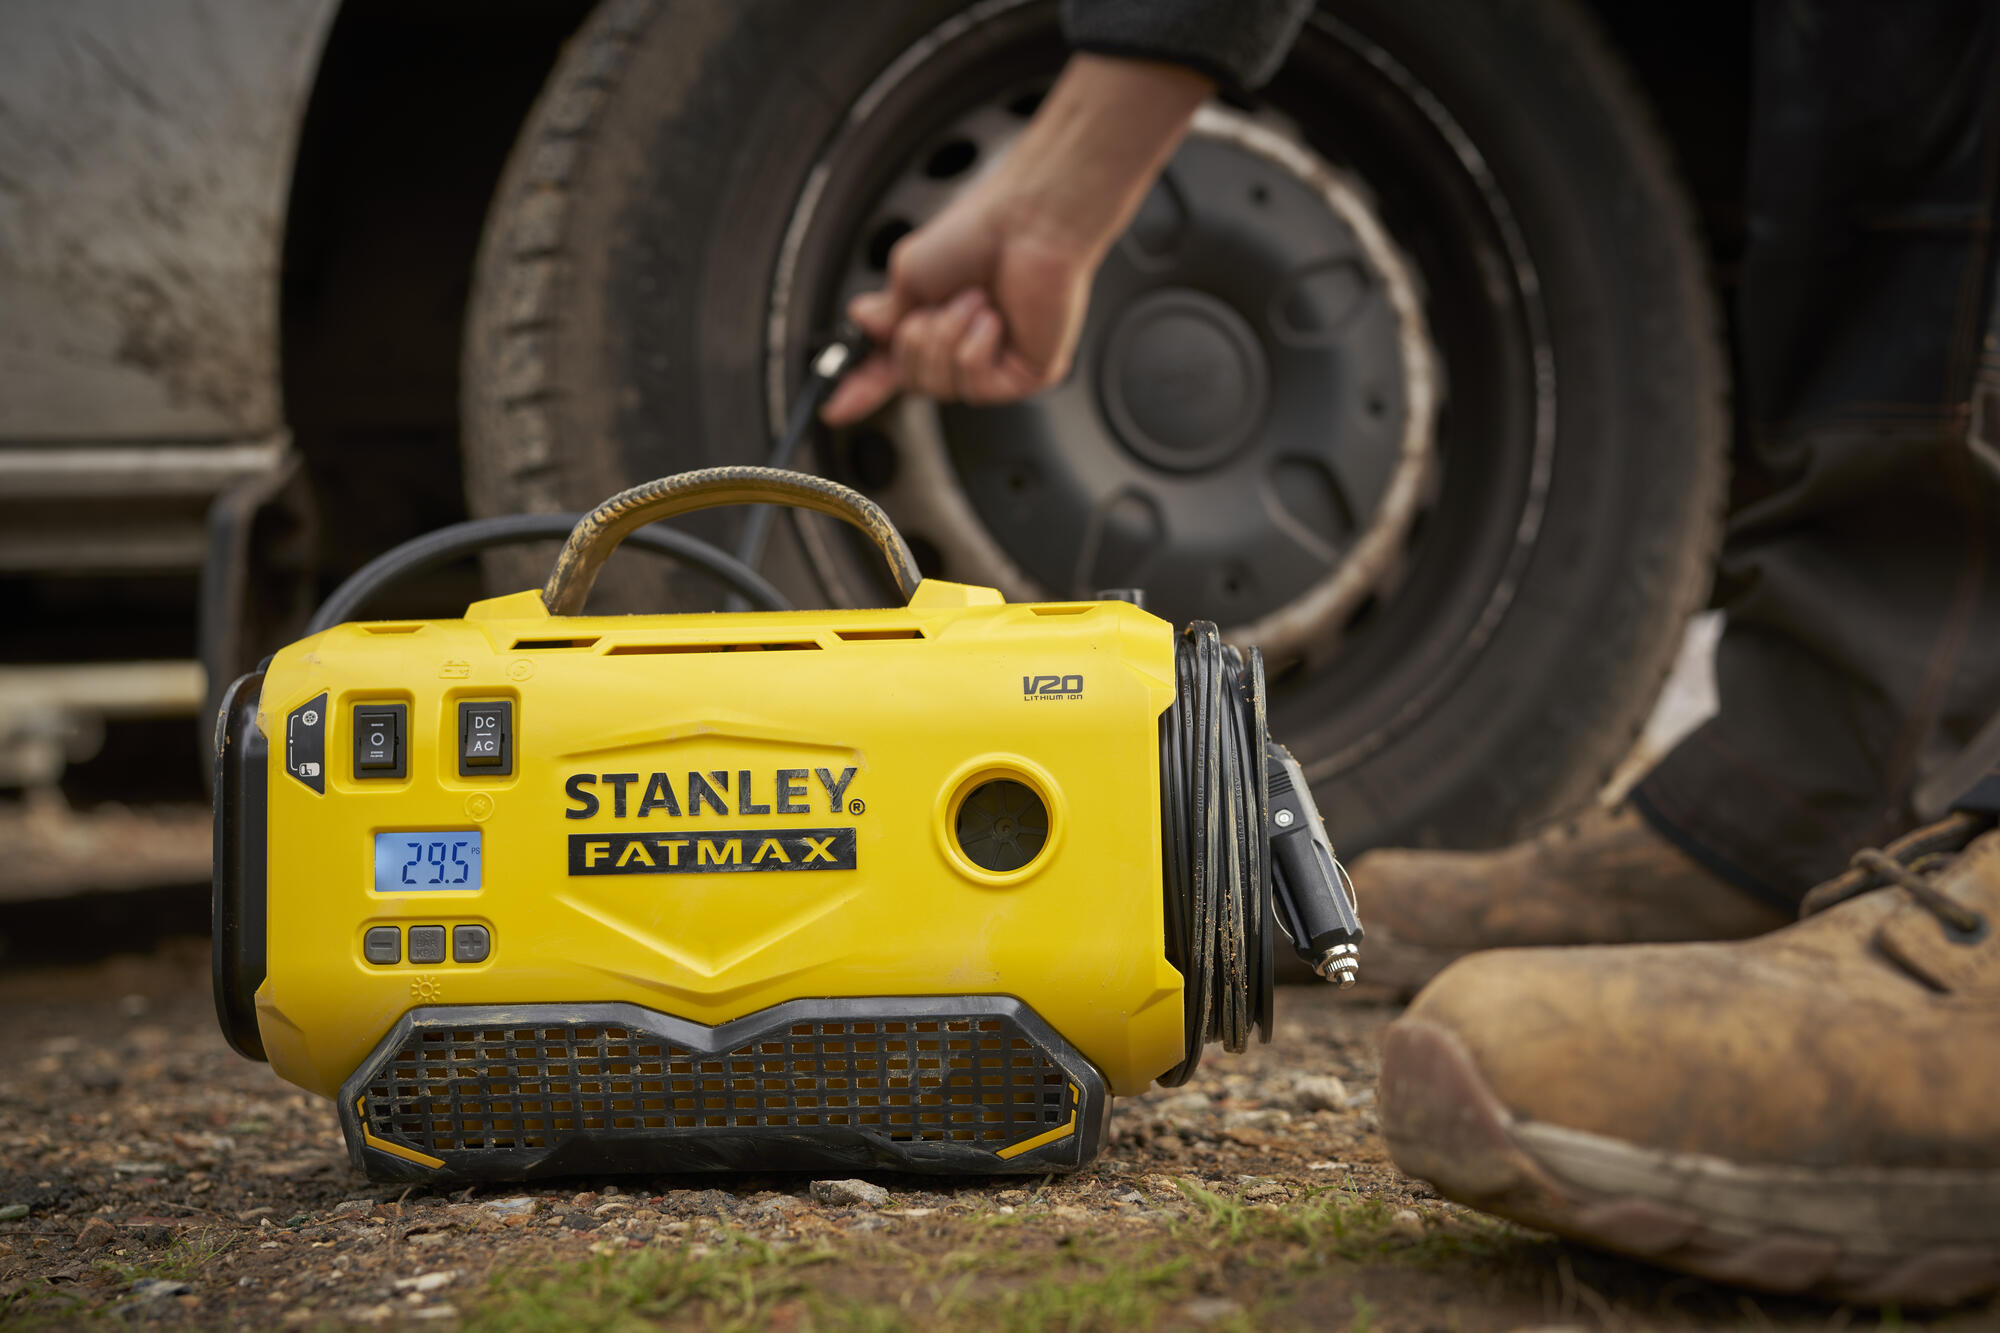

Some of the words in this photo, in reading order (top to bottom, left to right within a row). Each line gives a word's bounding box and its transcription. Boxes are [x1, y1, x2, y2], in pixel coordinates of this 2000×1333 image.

[1023, 675, 1083, 694] V20
[475, 716, 496, 729] DC
[473, 740, 494, 752] AC
[584, 836, 839, 868] FATMAX
[402, 841, 468, 885] 29.5
